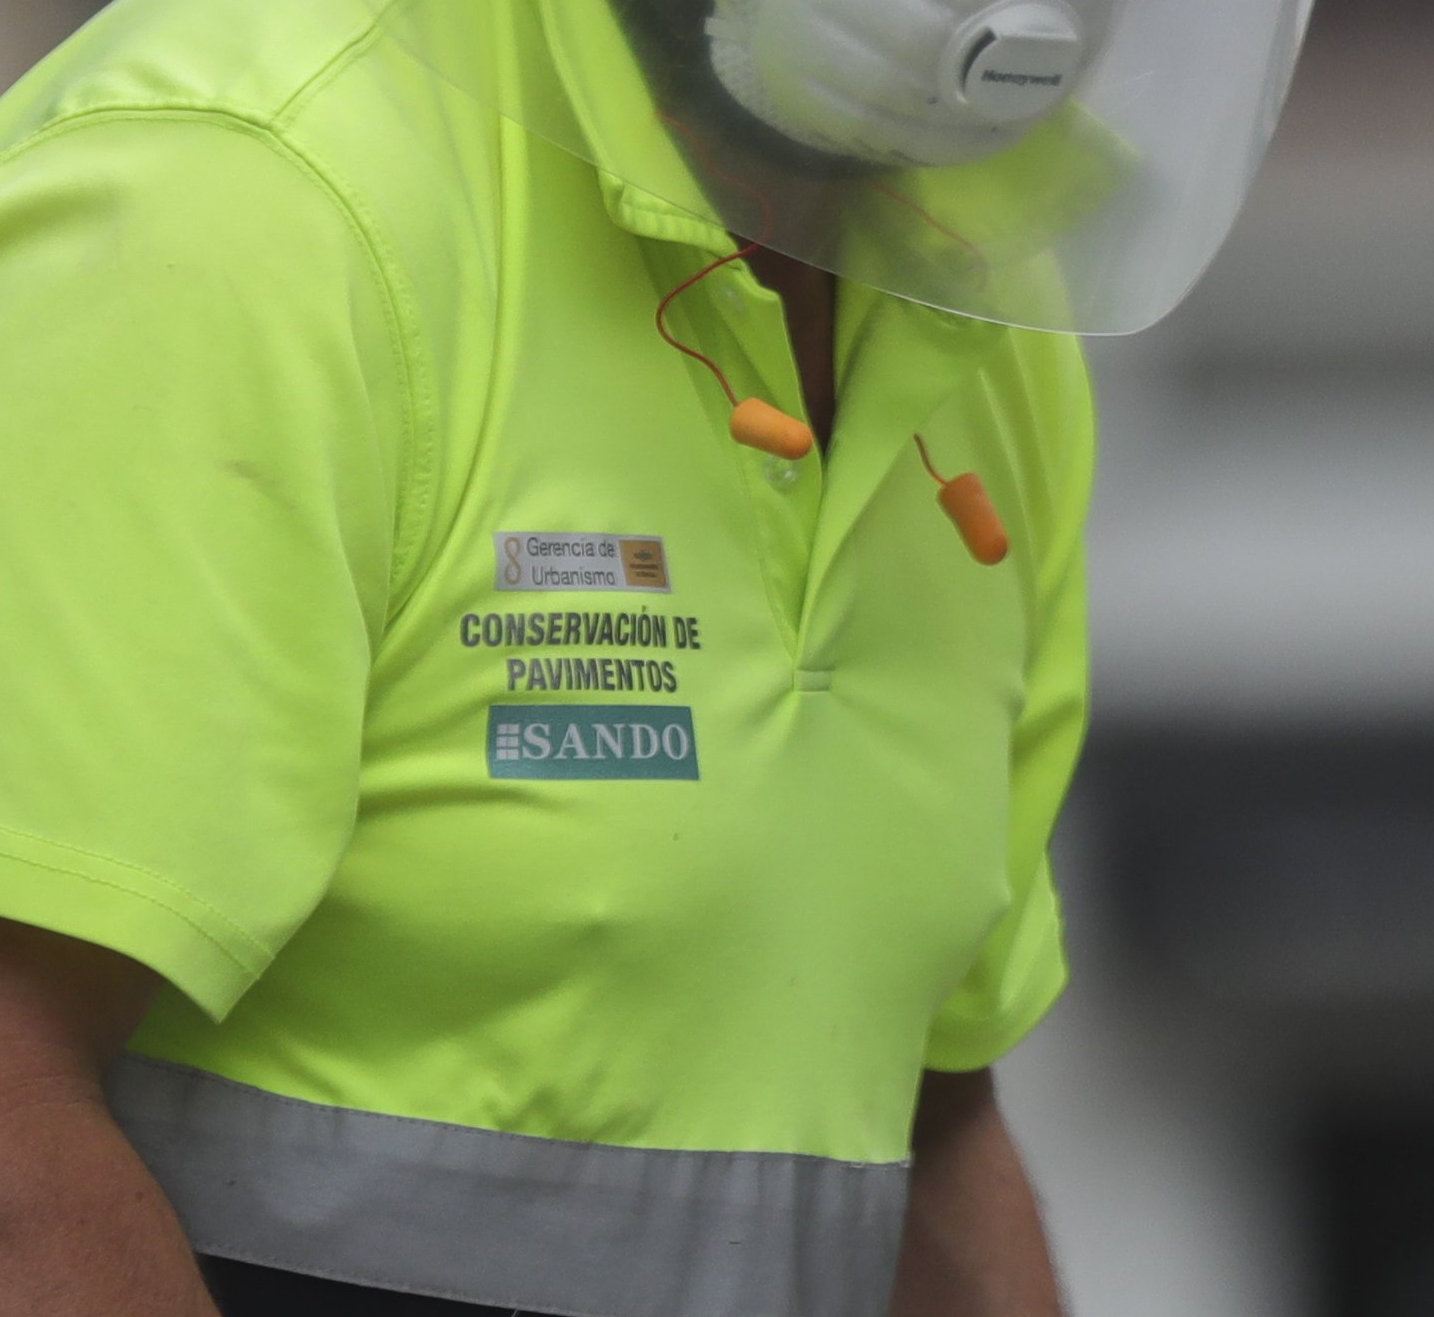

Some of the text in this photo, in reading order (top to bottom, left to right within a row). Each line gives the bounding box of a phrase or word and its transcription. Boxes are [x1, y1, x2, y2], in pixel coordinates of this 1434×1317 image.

[526, 537, 594, 557] Gerencia
[599, 540, 615, 558] de
[531, 567, 616, 586] Urbanismo
[460, 606, 701, 649] CONSERVACIÓN DE
[506, 658, 677, 693] PAVIMENTOS
[522, 723, 689, 760] SANDO
